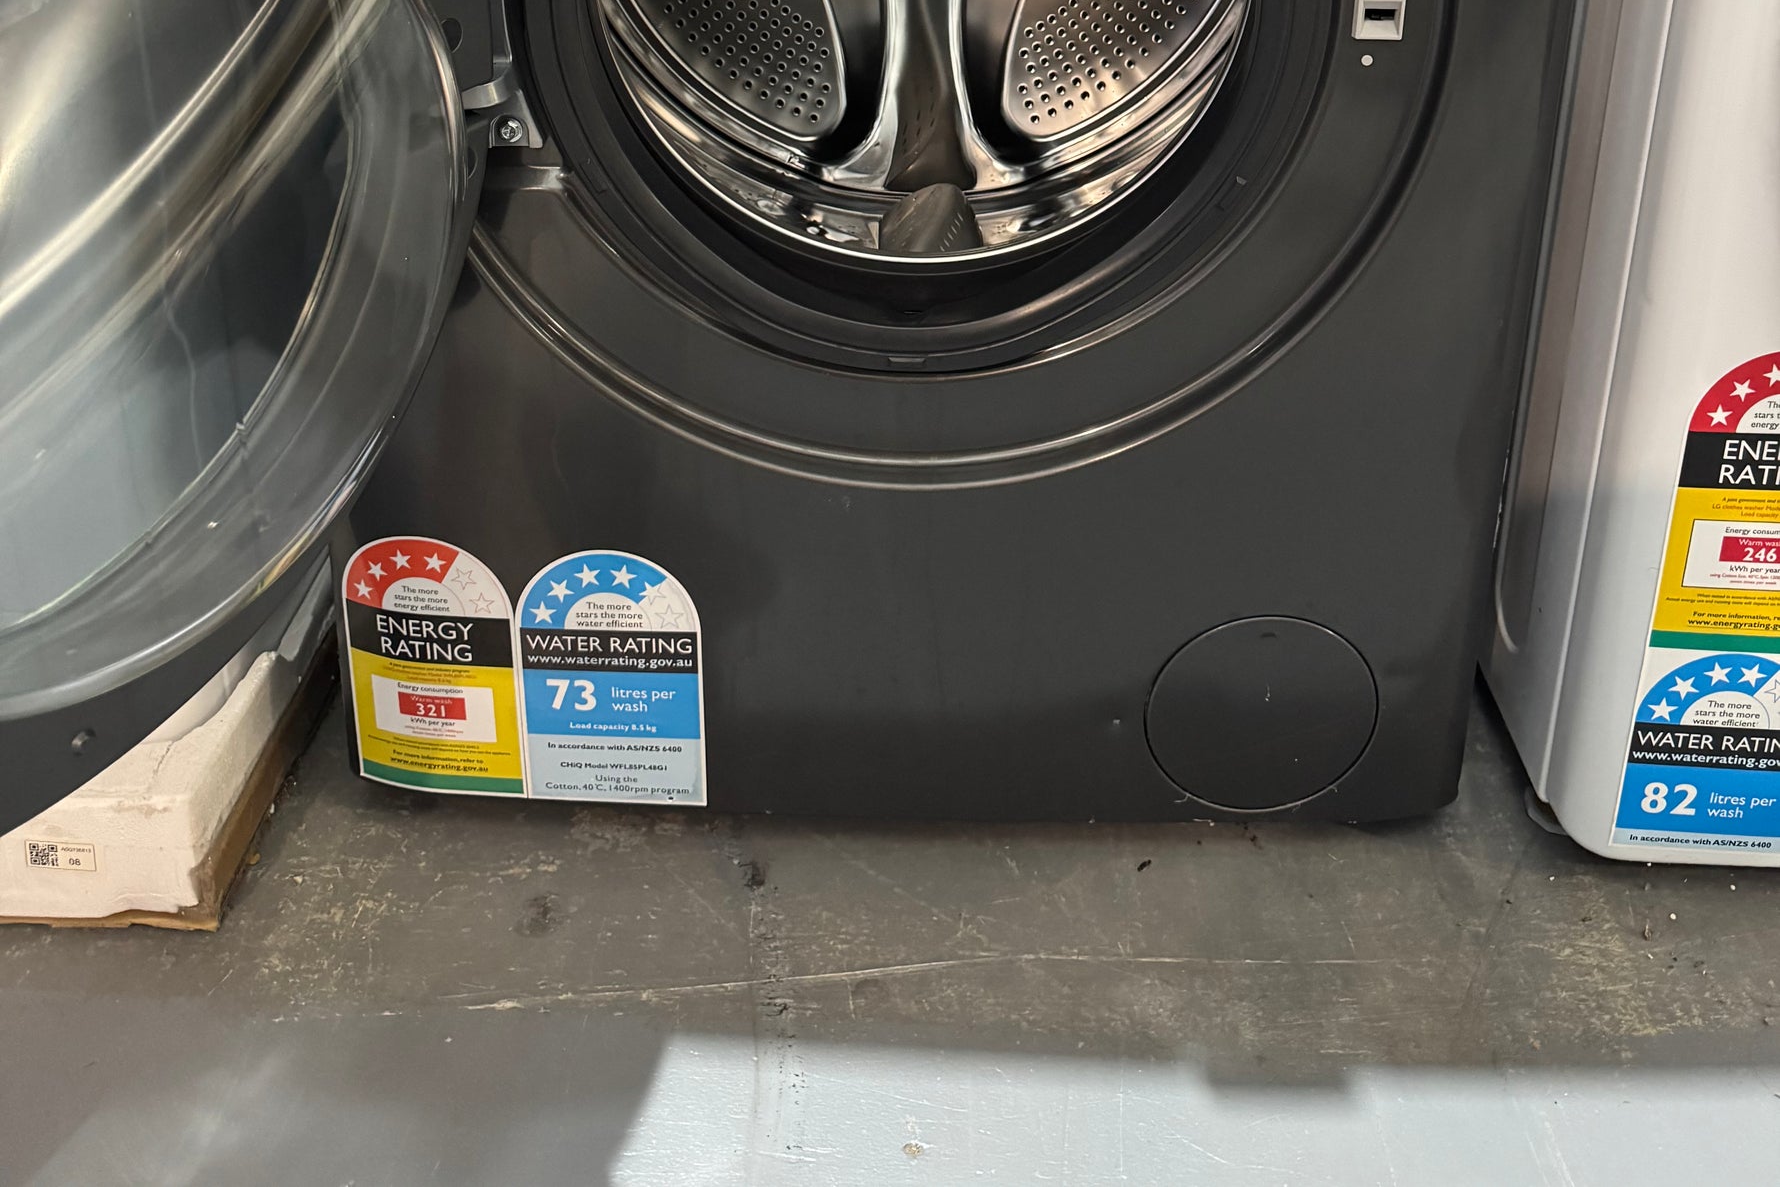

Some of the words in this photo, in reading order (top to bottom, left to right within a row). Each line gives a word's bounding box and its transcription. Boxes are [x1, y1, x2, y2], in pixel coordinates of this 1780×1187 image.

[1751, 421, 1779, 430] energy
[1723, 440, 1780, 461] ENE
[1725, 527, 1750, 536] Energy
[1739, 539, 1763, 547] Warm
[1743, 548, 1777, 562] 246
[401, 585, 416, 594] The
[394, 594, 412, 602] stars
[413, 595, 426, 603] the
[394, 602, 419, 611] energy
[420, 604, 450, 612] efficient
[586, 601, 605, 610] The
[606, 603, 632, 611] more
[576, 611, 599, 619] stars
[600, 611, 616, 619] the
[376, 614, 474, 641] ENERGY
[576, 620, 604, 628] water
[606, 620, 643, 628] efficient
[1688, 619, 1780, 630] www.energyrating.g
[381, 636, 473, 662] RATING
[526, 635, 603, 653] WATER
[609, 637, 692, 654] RATING
[527, 654, 693, 669] www.waterrating.gov.au
[397, 682, 419, 691] Energy
[420, 686, 464, 695] consumption
[611, 686, 648, 699] litres
[651, 690, 676, 702] per
[545, 678, 597, 712] 73
[416, 703, 446, 717] 321
[612, 701, 648, 712] wash
[1708, 701, 1725, 709] The
[1728, 702, 1752, 710] more
[1695, 709, 1717, 717] stars
[1719, 710, 1734, 718] the
[569, 721, 592, 729] Load
[593, 723, 629, 732] capacity
[646, 724, 657, 733] kg
[1721, 719, 1757, 728] efficient
[1637, 730, 1714, 750] WATER
[557, 742, 605, 750] accordance
[626, 744, 661, 753] AS/NZS
[560, 761, 583, 769] CHiQ
[584, 762, 608, 770] Model
[595, 774, 621, 784] Using
[609, 783, 649, 794] 1400rpm
[651, 787, 690, 795] program
[1640, 781, 1698, 816] 82
[1709, 792, 1746, 806] litres
[1750, 797, 1777, 808] per
[1707, 807, 1744, 819] wash
[1640, 835, 1690, 845] accordance
[1692, 836, 1711, 846] with
[1712, 838, 1749, 848] AS/NZS
[1751, 840, 1772, 849] 6400
